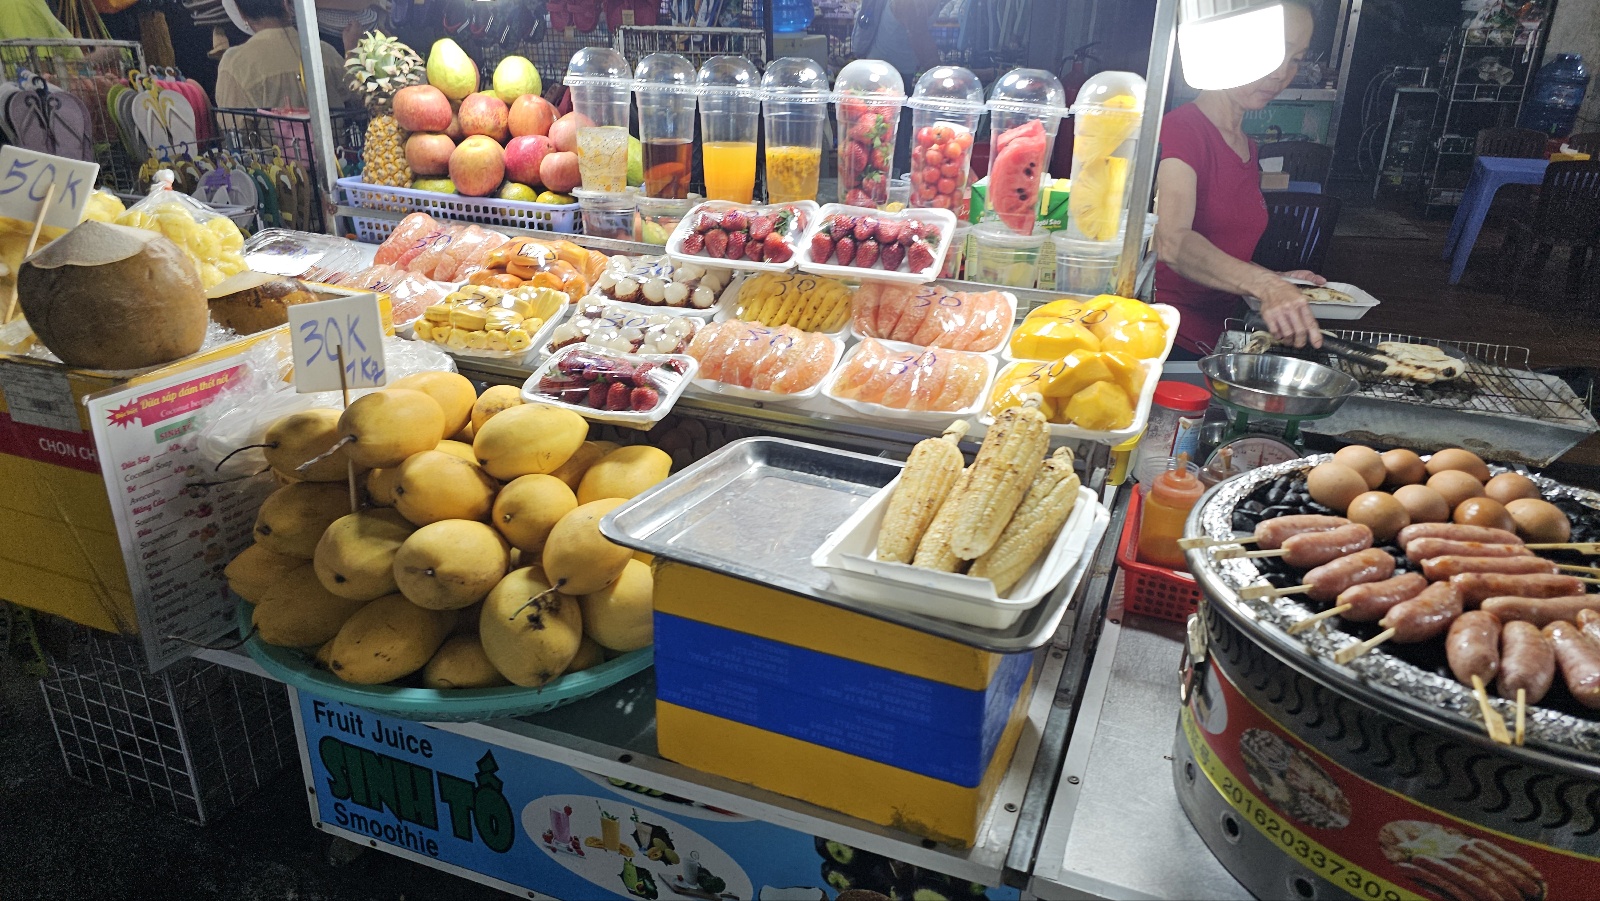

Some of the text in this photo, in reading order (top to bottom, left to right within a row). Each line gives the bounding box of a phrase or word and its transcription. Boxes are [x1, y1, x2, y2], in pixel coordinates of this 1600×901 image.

[773, 274, 816, 297] 30
[914, 289, 962, 308] 30
[599, 312, 647, 328] 30
[1057, 308, 1108, 325] 30
[299, 313, 367, 367] 30K
[312, 700, 434, 759] Fruit Juice
[318, 736, 440, 832] SINH
[333, 801, 440, 857] Smoothie
